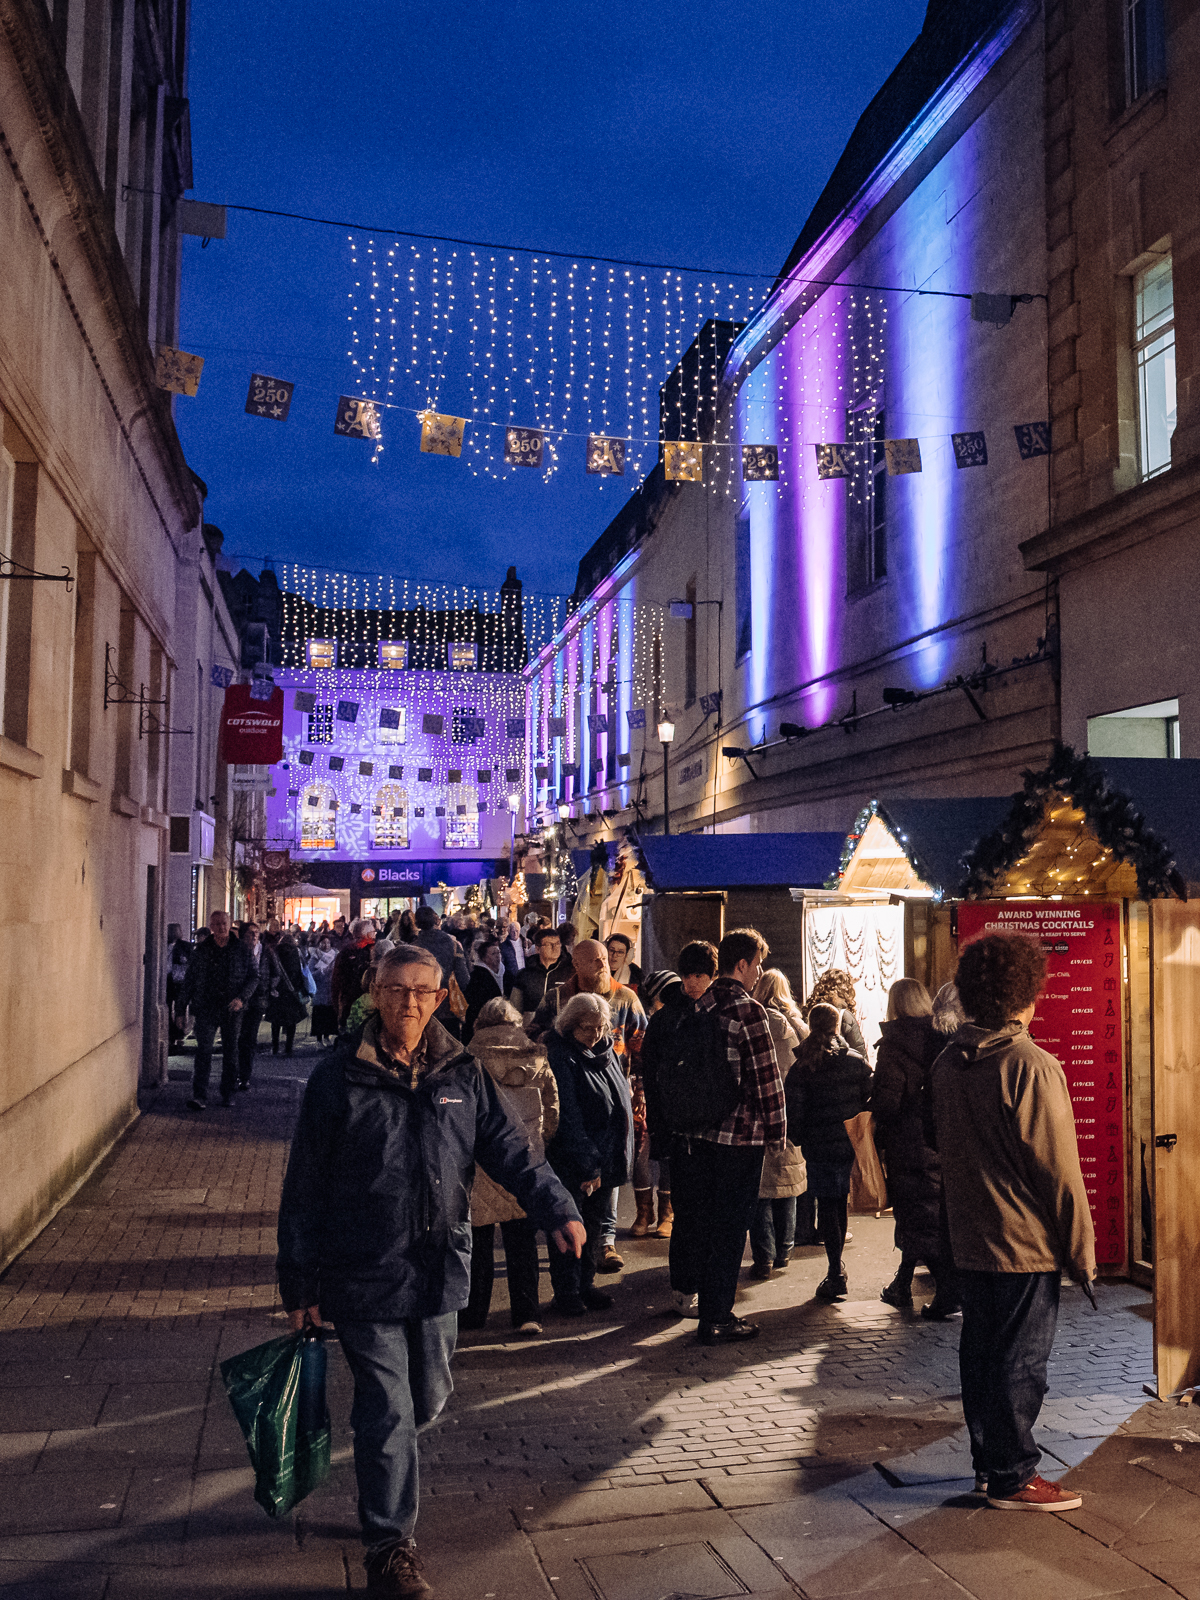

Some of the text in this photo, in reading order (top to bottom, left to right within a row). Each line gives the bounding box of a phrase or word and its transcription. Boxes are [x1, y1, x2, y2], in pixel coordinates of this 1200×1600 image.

[253, 388, 289, 404] 250
[509, 438, 541, 453] 250
[958, 438, 984, 457] 250
[747, 451, 776, 470] 250
[227, 718, 280, 727] COTSWOLD
[378, 868, 420, 881] Blacks
[998, 910, 1081, 919] AWARD WINNING
[985, 920, 1095, 930] CHRISTMAS COCKTAILS
